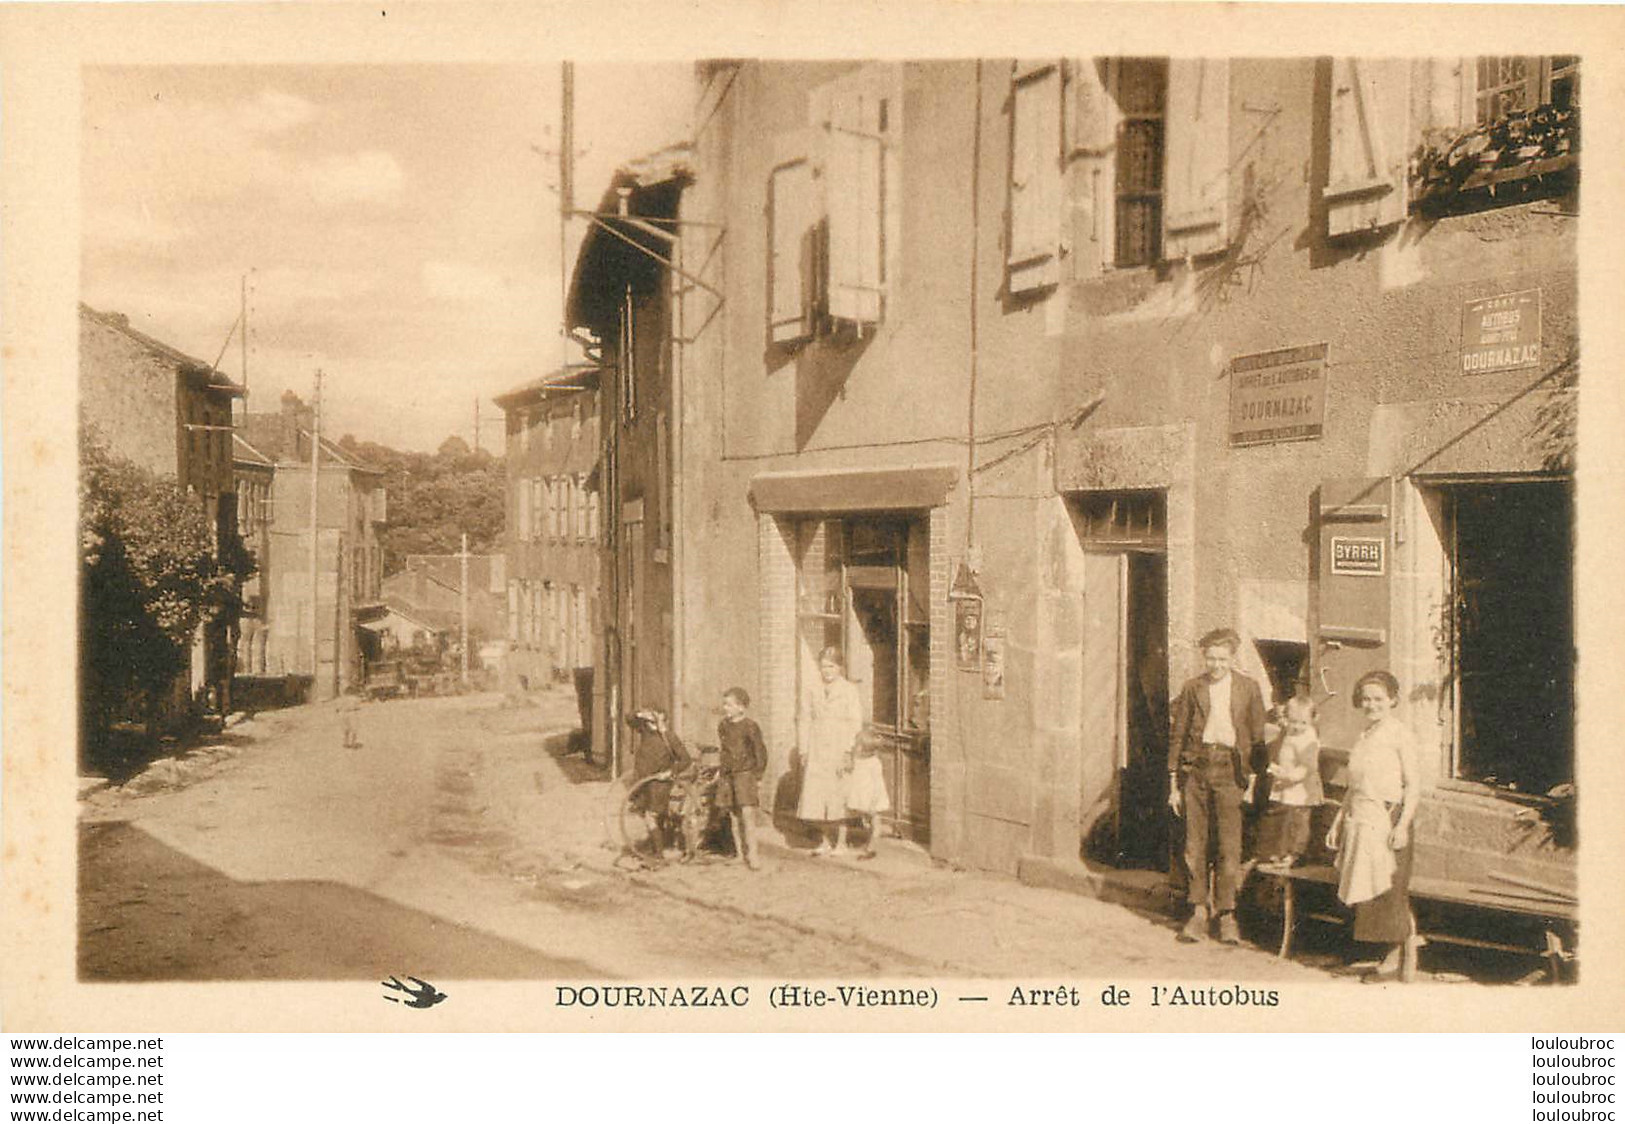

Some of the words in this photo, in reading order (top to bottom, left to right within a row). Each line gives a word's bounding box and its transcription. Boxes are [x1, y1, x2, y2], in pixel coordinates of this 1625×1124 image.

[1463, 344, 1538, 371] DOURNAZAC
[1242, 395, 1313, 420] DOURNAZAC
[1336, 544, 1378, 560] BYRRH
